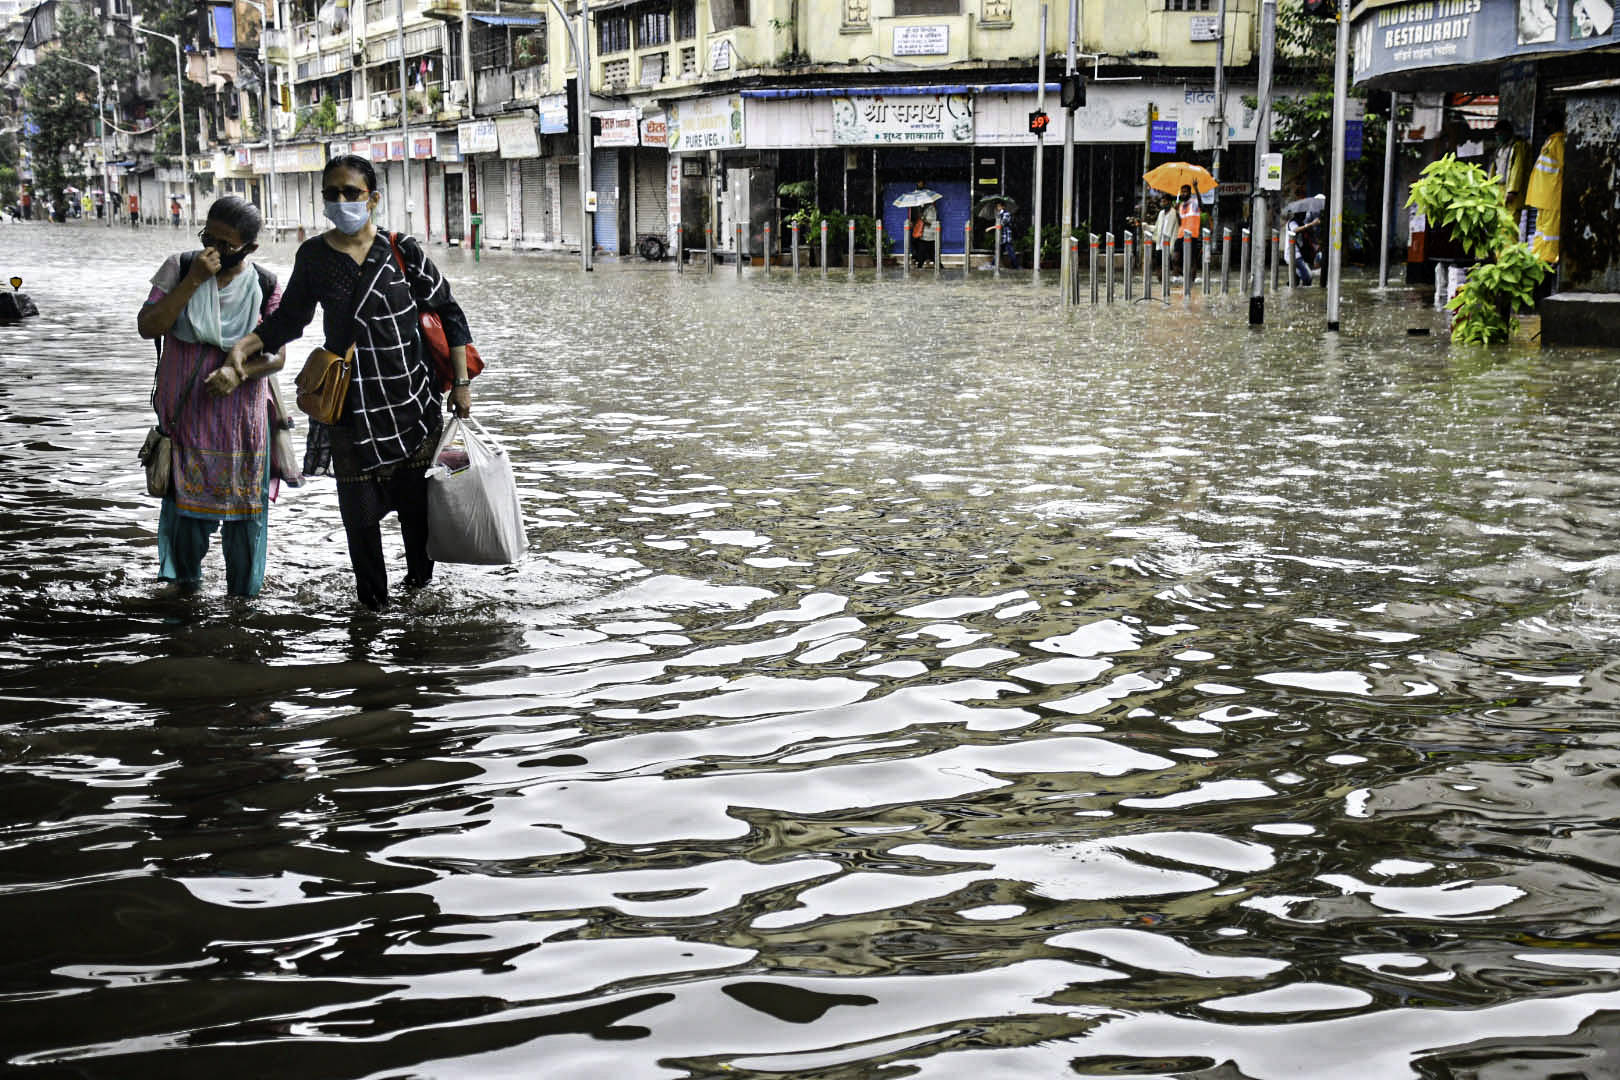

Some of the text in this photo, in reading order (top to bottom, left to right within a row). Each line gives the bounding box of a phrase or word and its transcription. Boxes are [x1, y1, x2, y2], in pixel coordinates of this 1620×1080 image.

[1378, 0, 1481, 28] MODERN TIMES
[1384, 18, 1470, 48] RESTAURANT
[685, 134, 702, 148] PURE
